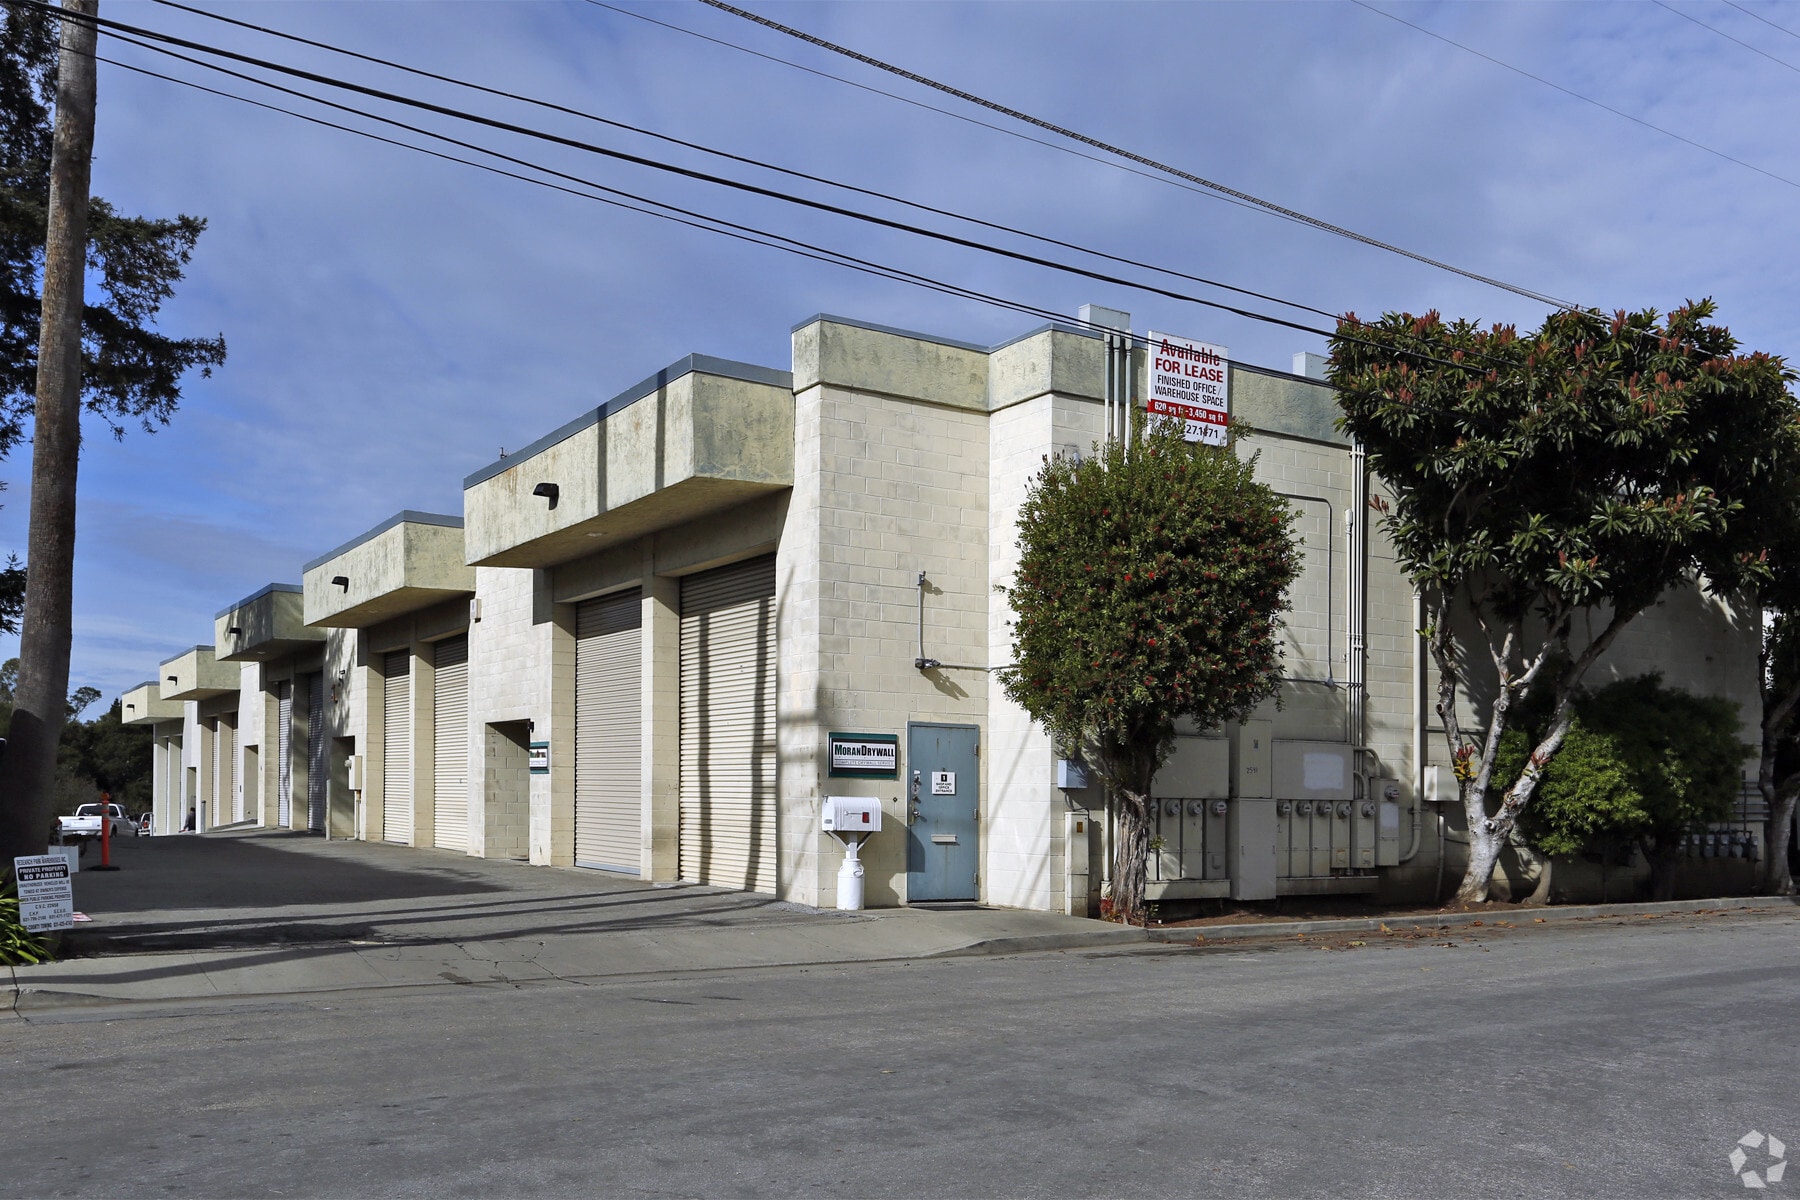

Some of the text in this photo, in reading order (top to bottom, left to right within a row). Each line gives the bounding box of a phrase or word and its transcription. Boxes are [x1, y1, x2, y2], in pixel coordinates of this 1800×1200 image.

[1160, 339, 1220, 366] Available
[1155, 358, 1223, 382] FOR LEASE
[1158, 374, 1190, 390] FINISHED
[1154, 385, 1224, 407] WAREHOUSE SPACE
[1154, 402, 1166, 412] 620
[1208, 414, 1216, 422] sq
[1218, 413, 1224, 422] ft
